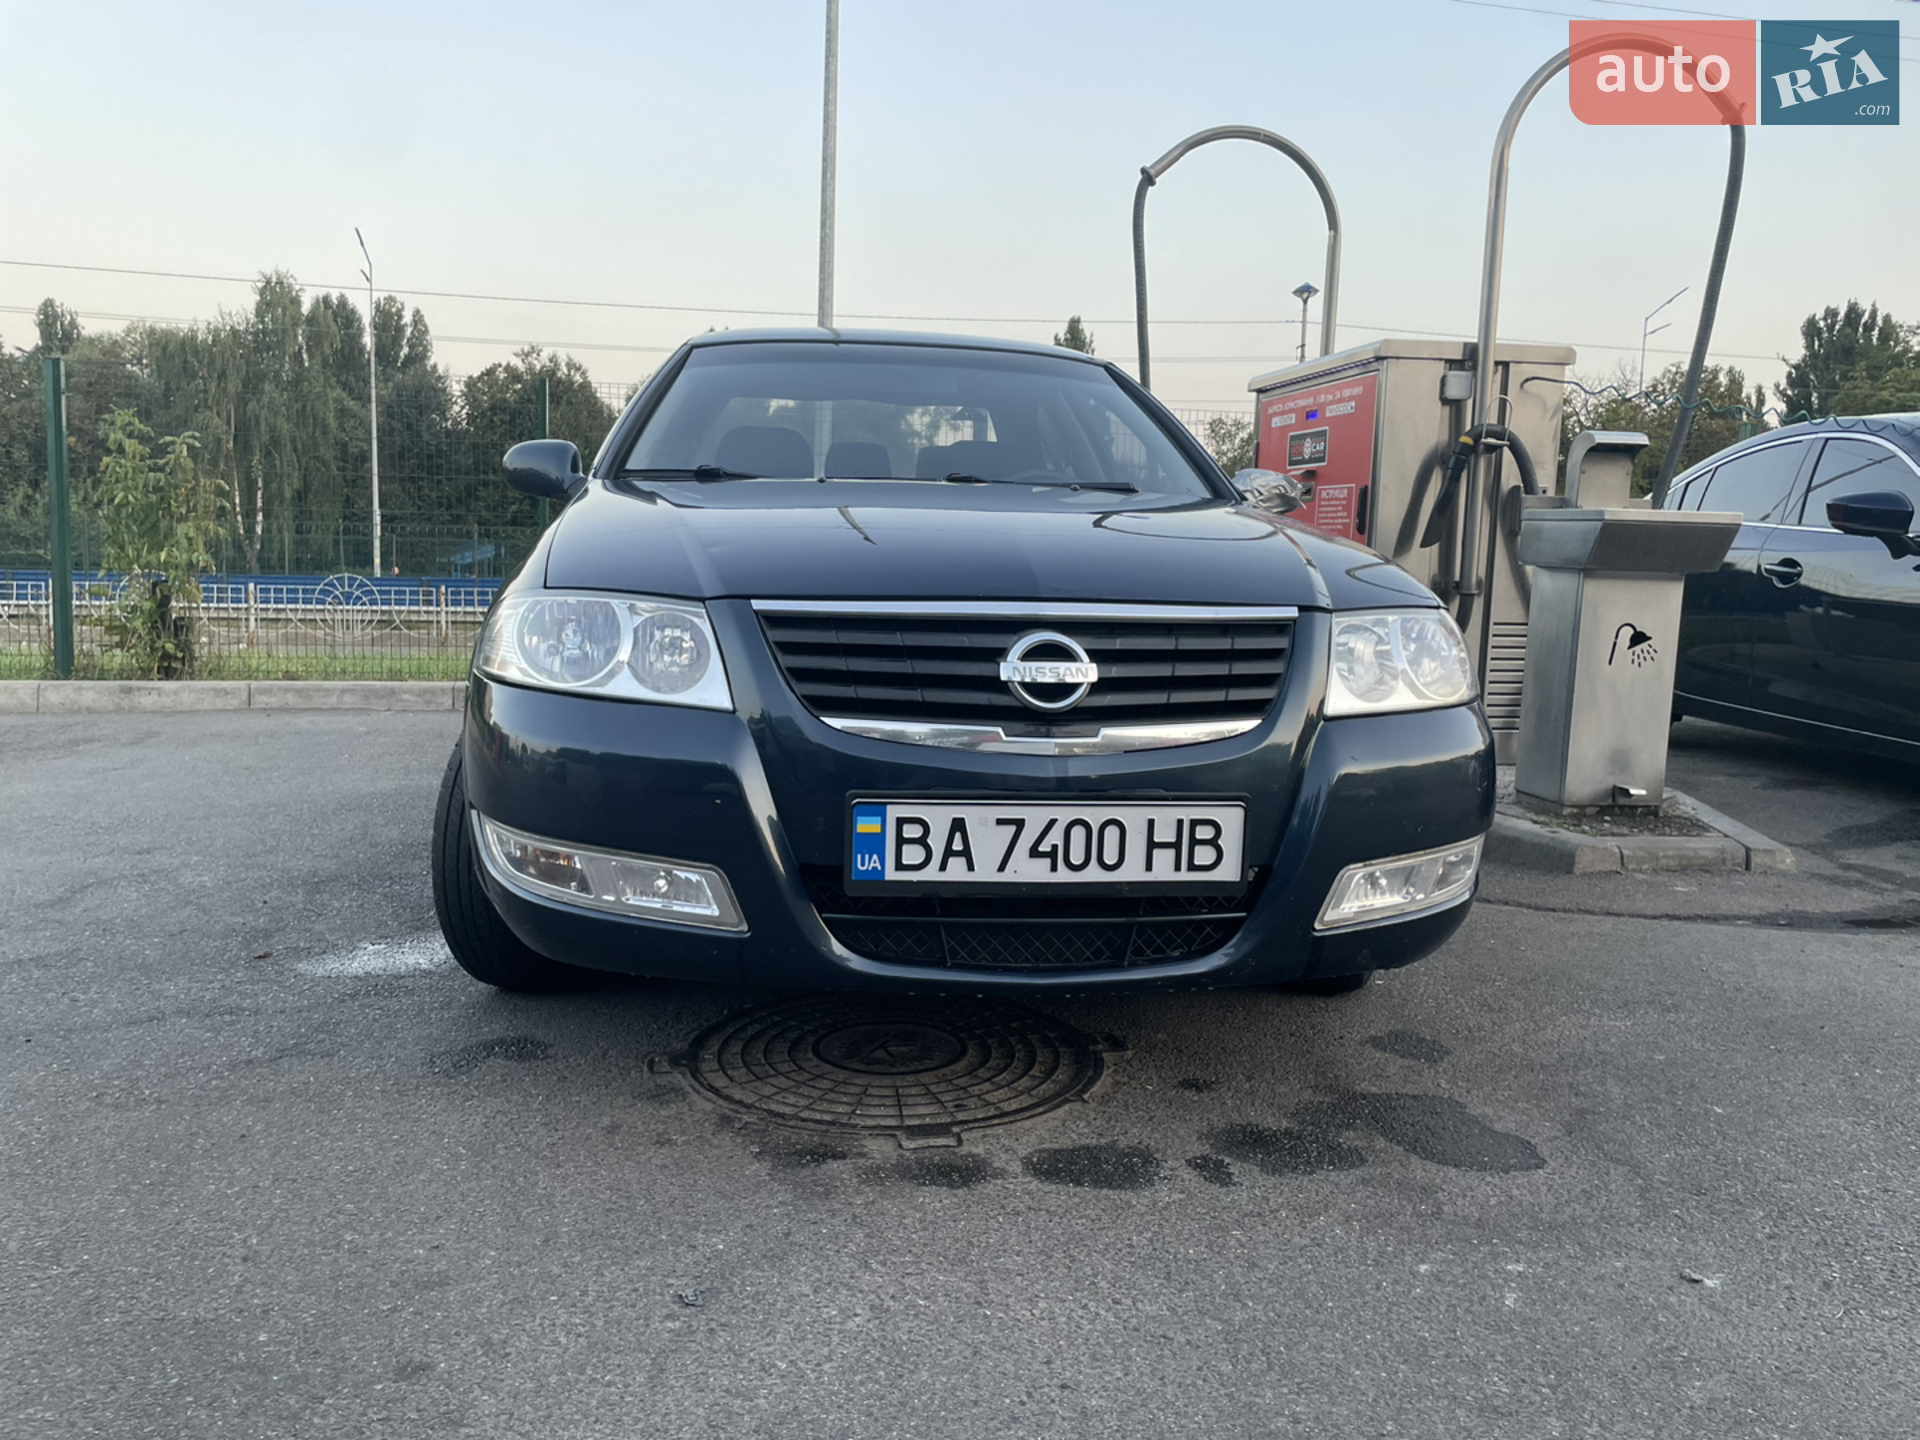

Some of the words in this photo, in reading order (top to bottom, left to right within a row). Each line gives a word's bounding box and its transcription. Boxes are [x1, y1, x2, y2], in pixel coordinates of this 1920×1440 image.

[1012, 666, 1089, 679] NISSAN
[894, 815, 976, 873] BA
[995, 816, 1127, 873] 7400
[1145, 816, 1225, 873] HB
[856, 854, 882, 871] UA
